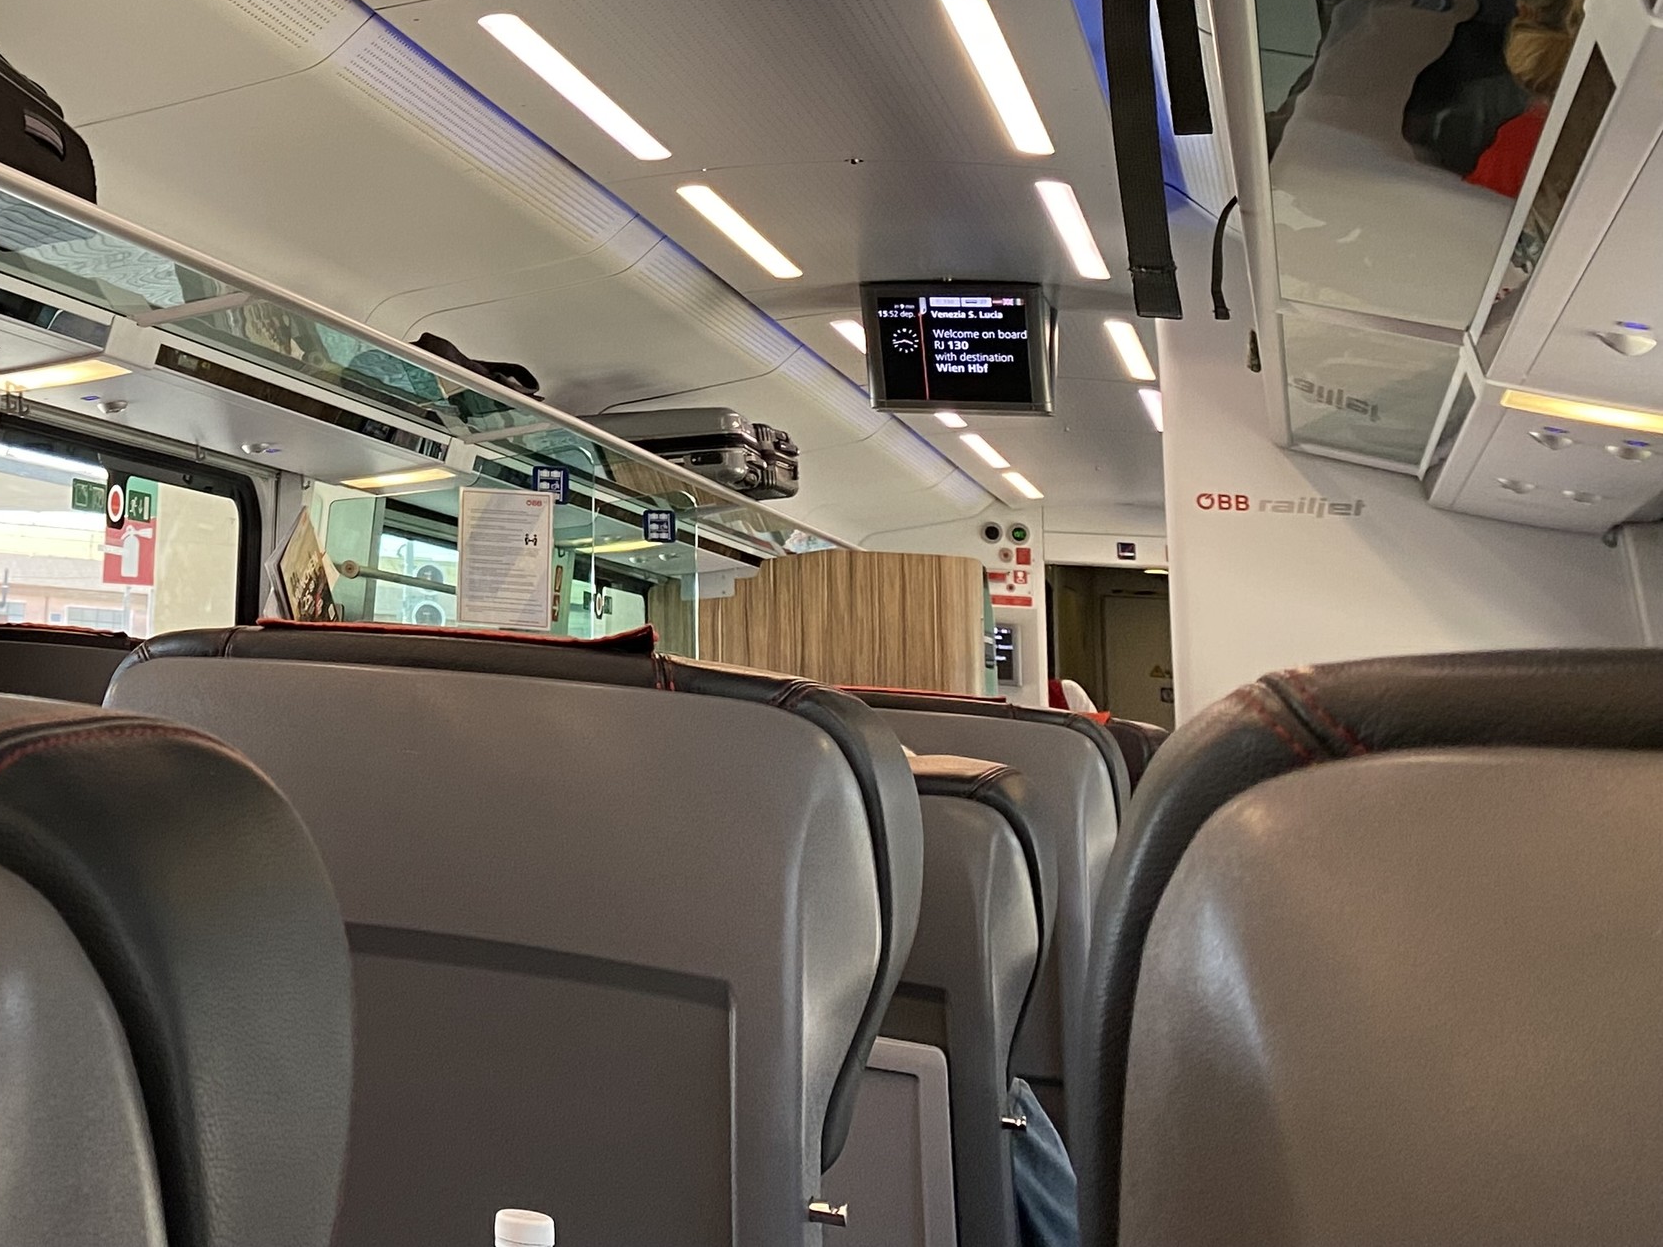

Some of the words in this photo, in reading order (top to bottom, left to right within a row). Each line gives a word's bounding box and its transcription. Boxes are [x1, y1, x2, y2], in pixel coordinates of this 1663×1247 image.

[900, 310, 915, 319] dep.
[931, 311, 966, 319] Venezia
[968, 311, 977, 319] S.
[979, 310, 1003, 319] Lucia
[933, 329, 980, 339] Welcome
[982, 331, 995, 339] on
[998, 330, 1027, 339] board
[934, 341, 945, 350] RJ
[948, 341, 969, 350] 130
[935, 352, 957, 362] with
[960, 352, 1014, 362] destination
[936, 363, 965, 373] Wien
[968, 363, 989, 373] Hbf
[1196, 493, 1250, 511] ÖBB
[1258, 497, 1366, 518] railjet
